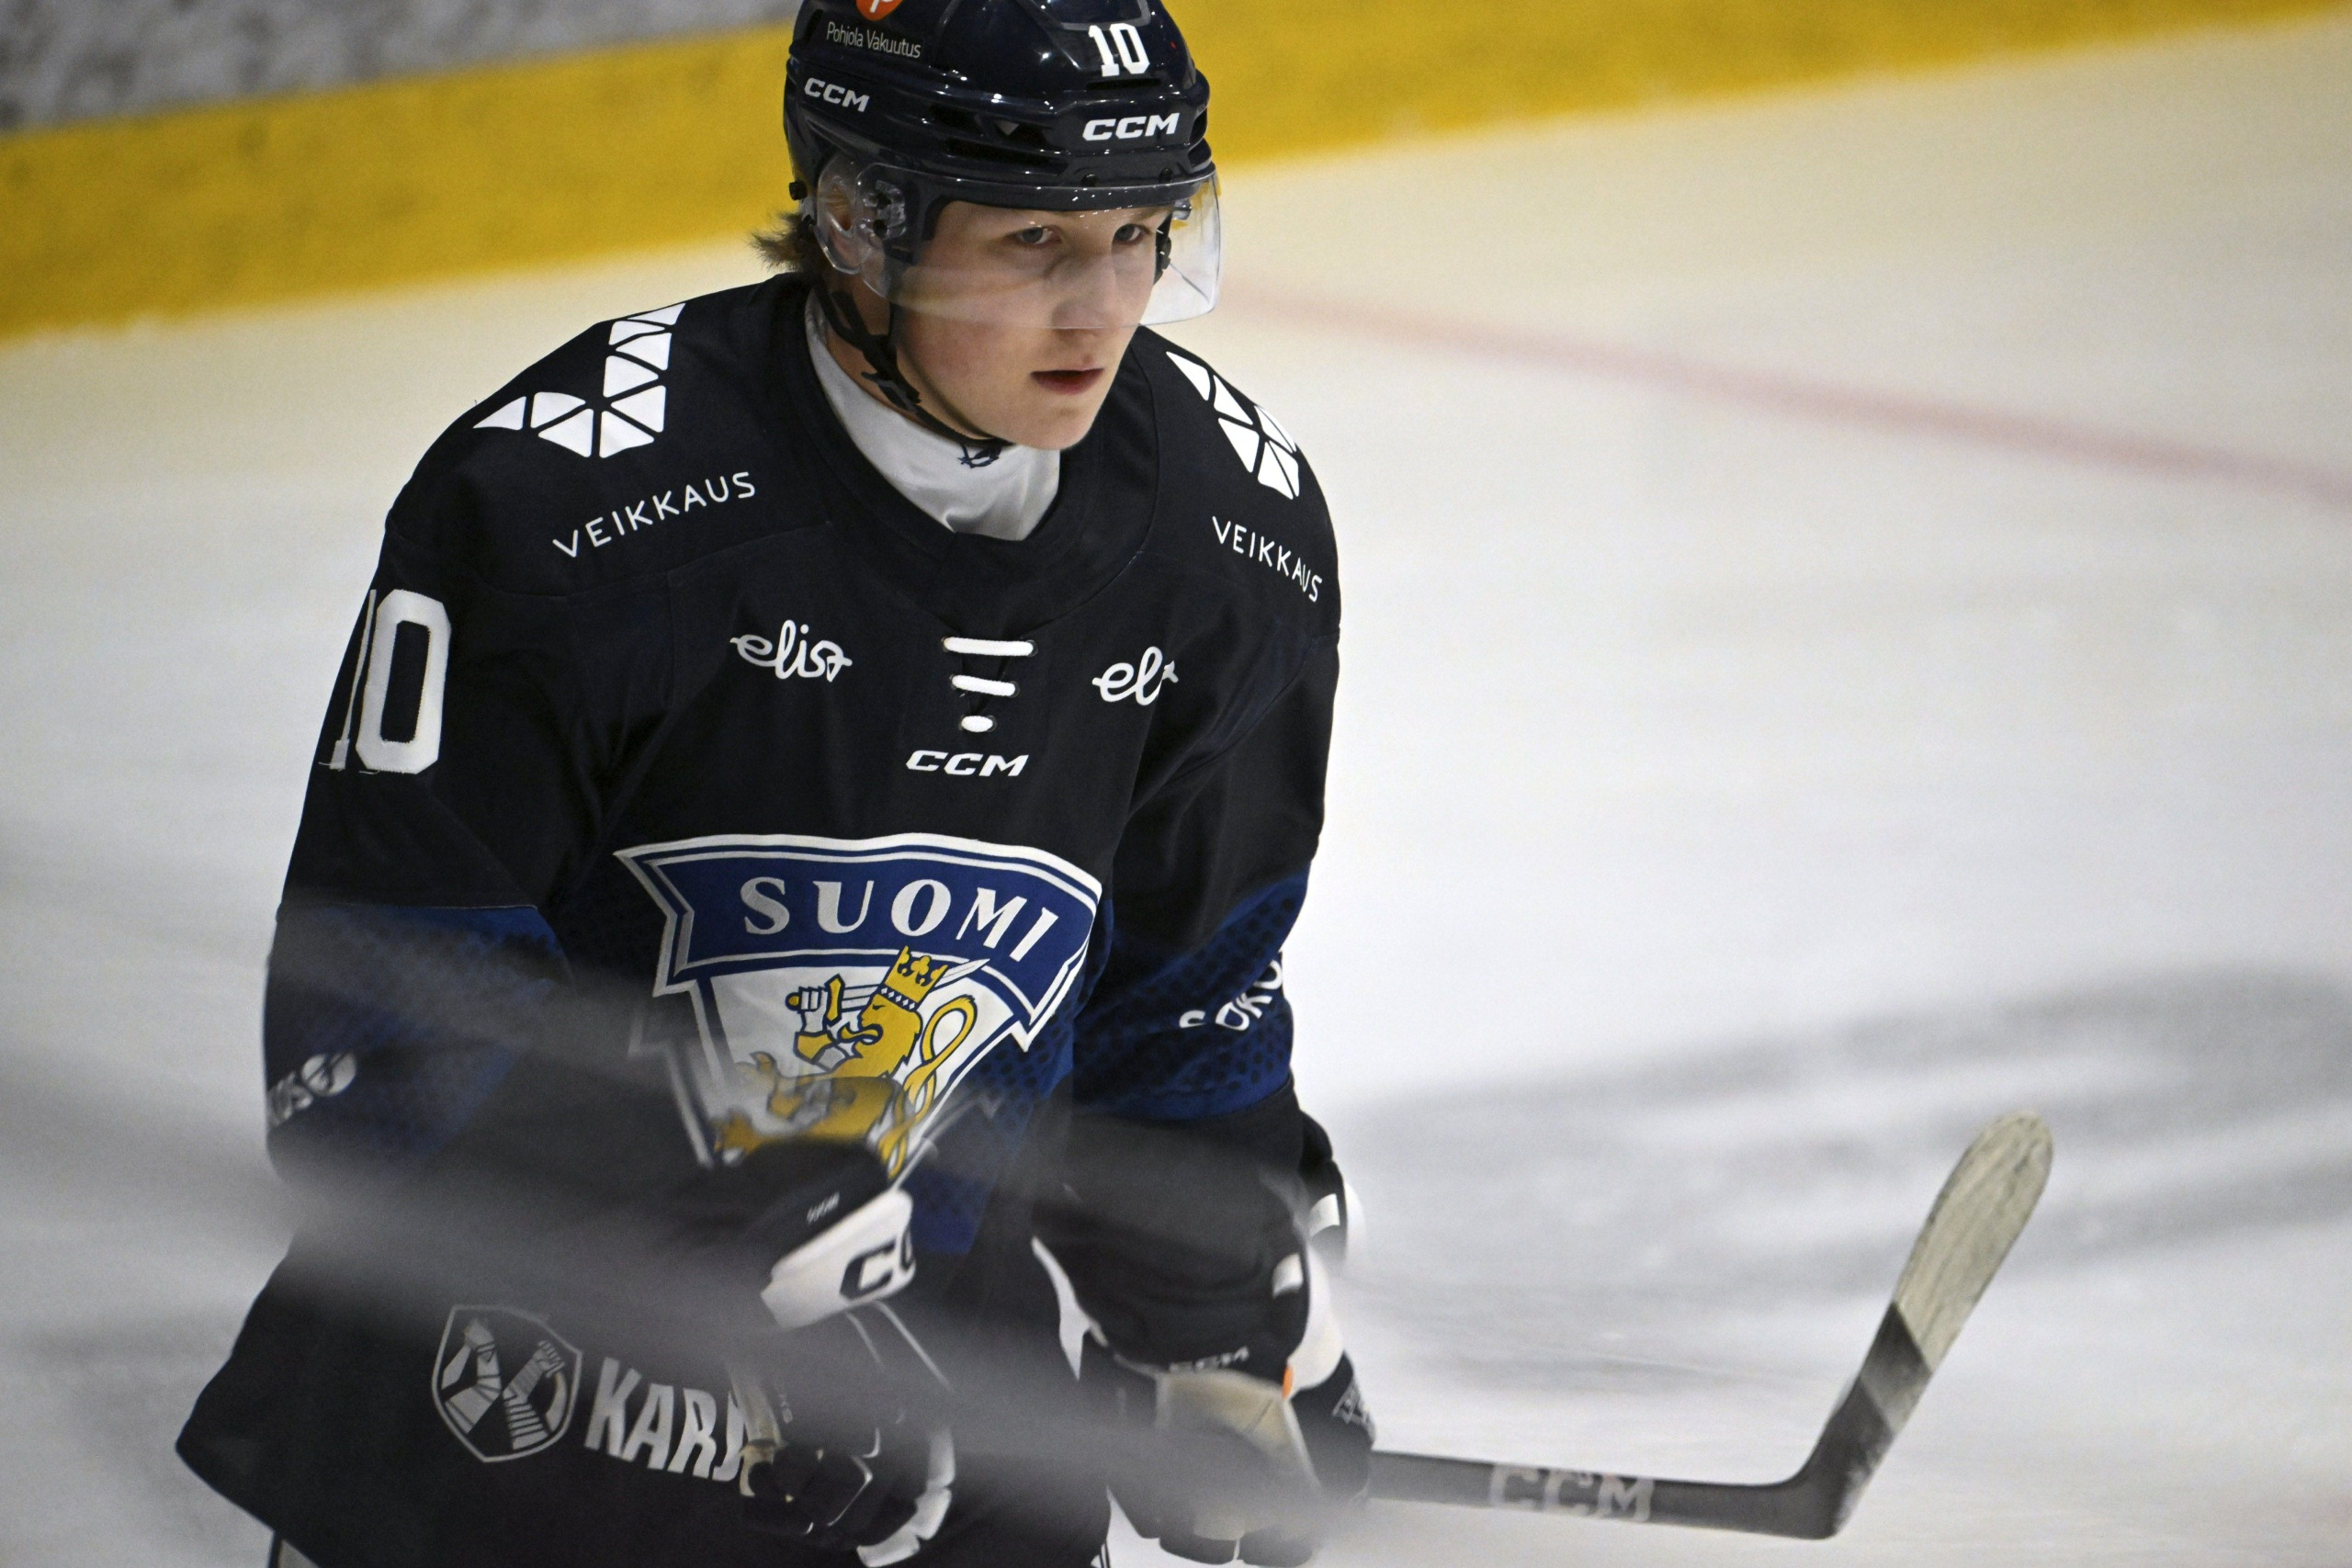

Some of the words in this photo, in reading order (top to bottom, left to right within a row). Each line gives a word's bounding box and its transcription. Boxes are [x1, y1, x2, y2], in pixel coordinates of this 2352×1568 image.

[827, 21, 864, 48] Pohjola
[866, 29, 922, 58] Vakuutus
[1088, 23, 1150, 77] 10
[804, 77, 870, 112] CCM
[1082, 112, 1181, 141] CCM
[552, 471, 755, 558] VEIKKAUS
[1212, 515, 1323, 603] VEIKKAUS
[1091, 646, 1179, 705] el
[906, 750, 1029, 776] CCM
[740, 876, 1059, 962] SUOMI
[1488, 1462, 1656, 1523] CCM
